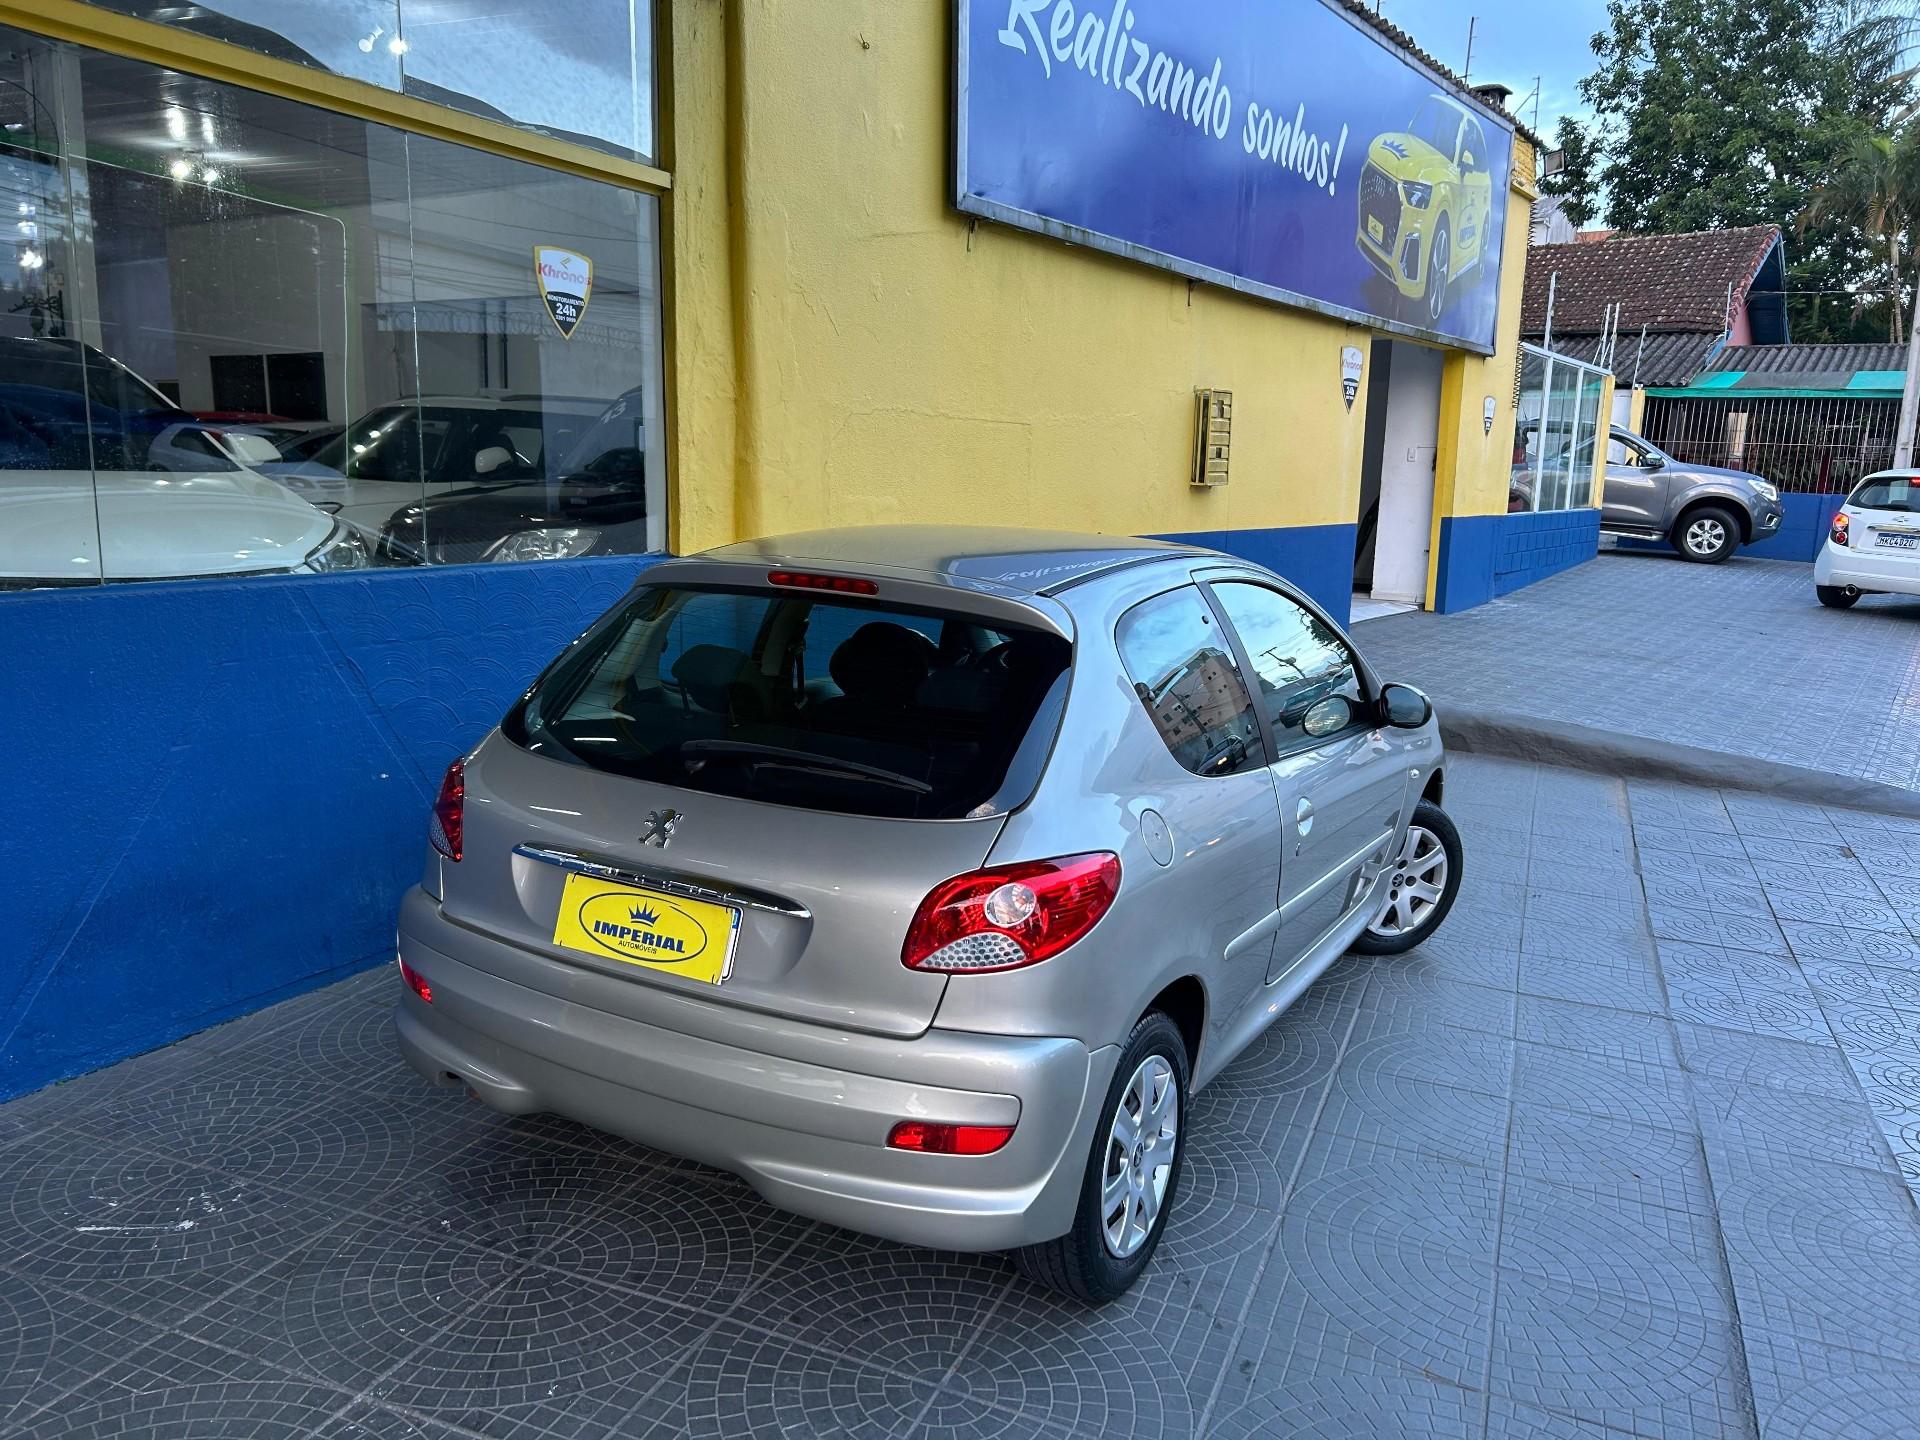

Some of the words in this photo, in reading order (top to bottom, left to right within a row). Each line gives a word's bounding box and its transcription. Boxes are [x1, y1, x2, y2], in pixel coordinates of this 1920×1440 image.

[998, 0, 1231, 139] Realizando
[1243, 102, 1348, 196] sonhos!
[538, 262, 591, 286] Khronos
[556, 303, 576, 317] 24h
[594, 920, 685, 954] IMPERIAL
